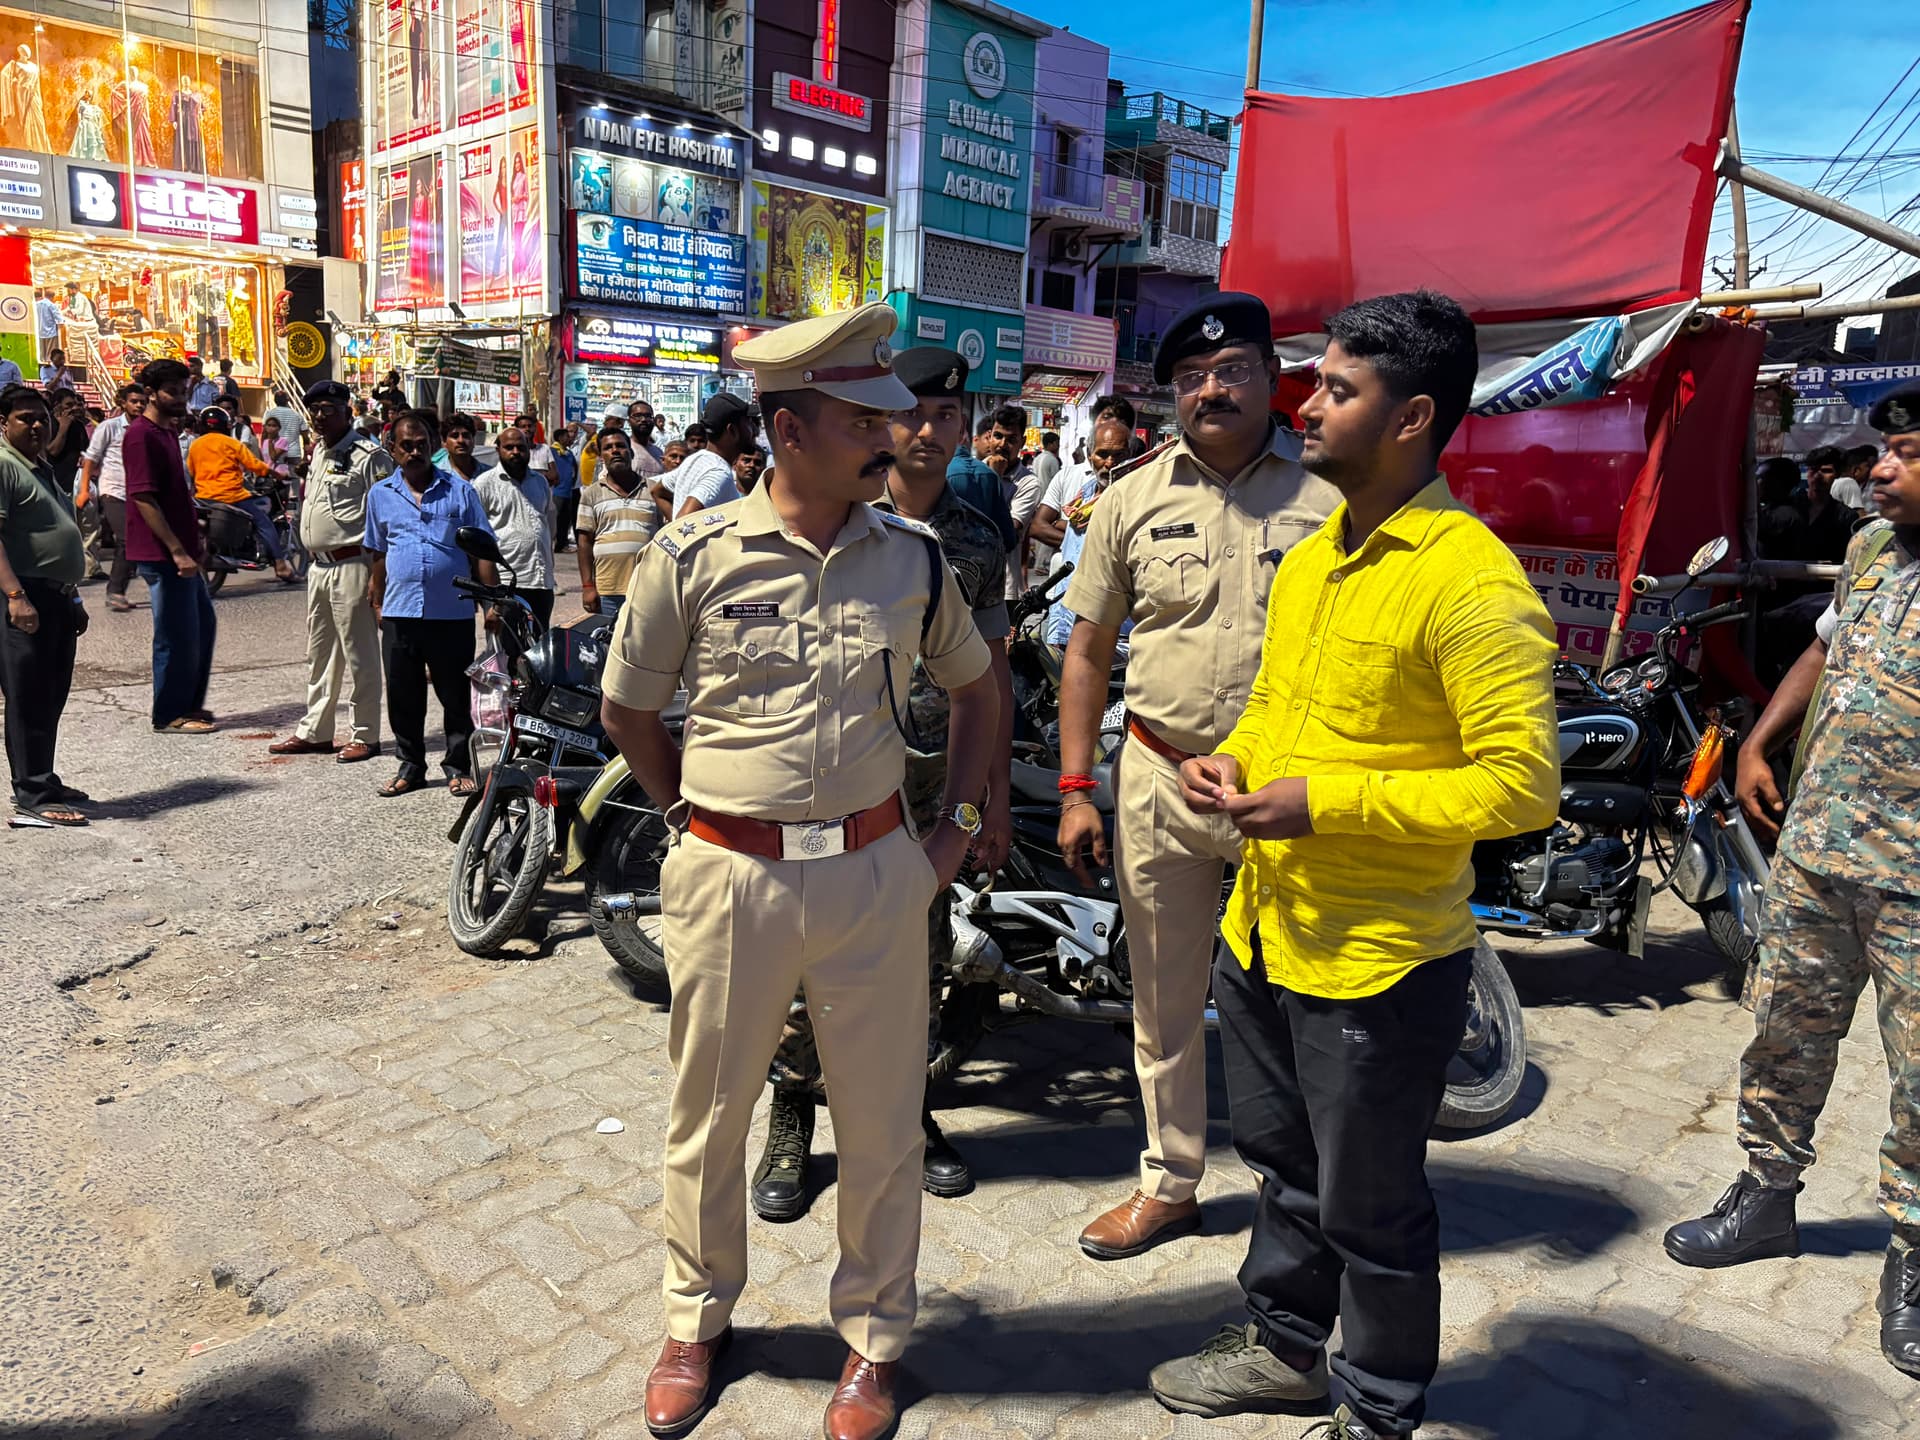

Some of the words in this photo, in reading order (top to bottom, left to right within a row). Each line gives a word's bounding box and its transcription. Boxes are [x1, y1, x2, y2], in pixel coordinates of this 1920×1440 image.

[789, 79, 865, 118] ELECTRIC
[947, 99, 1014, 142] KUMAR
[584, 117, 632, 147] NDAN
[635, 128, 665, 154] EYE
[669, 136, 736, 169] HOSPITAL
[940, 133, 1020, 178] MEDICAL
[0, 160, 18, 168] ADIES
[942, 170, 1016, 210] AGENCY
[623, 225, 659, 250] निदान
[661, 233, 686, 256] आई
[580, 269, 605, 284] बिना
[601, 286, 643, 302] (PHACO)
[1563, 553, 1588, 577] के
[1558, 581, 1673, 618] पेयल
[569, 732, 593, 747] 3209
[1598, 733, 1625, 743] Hero
